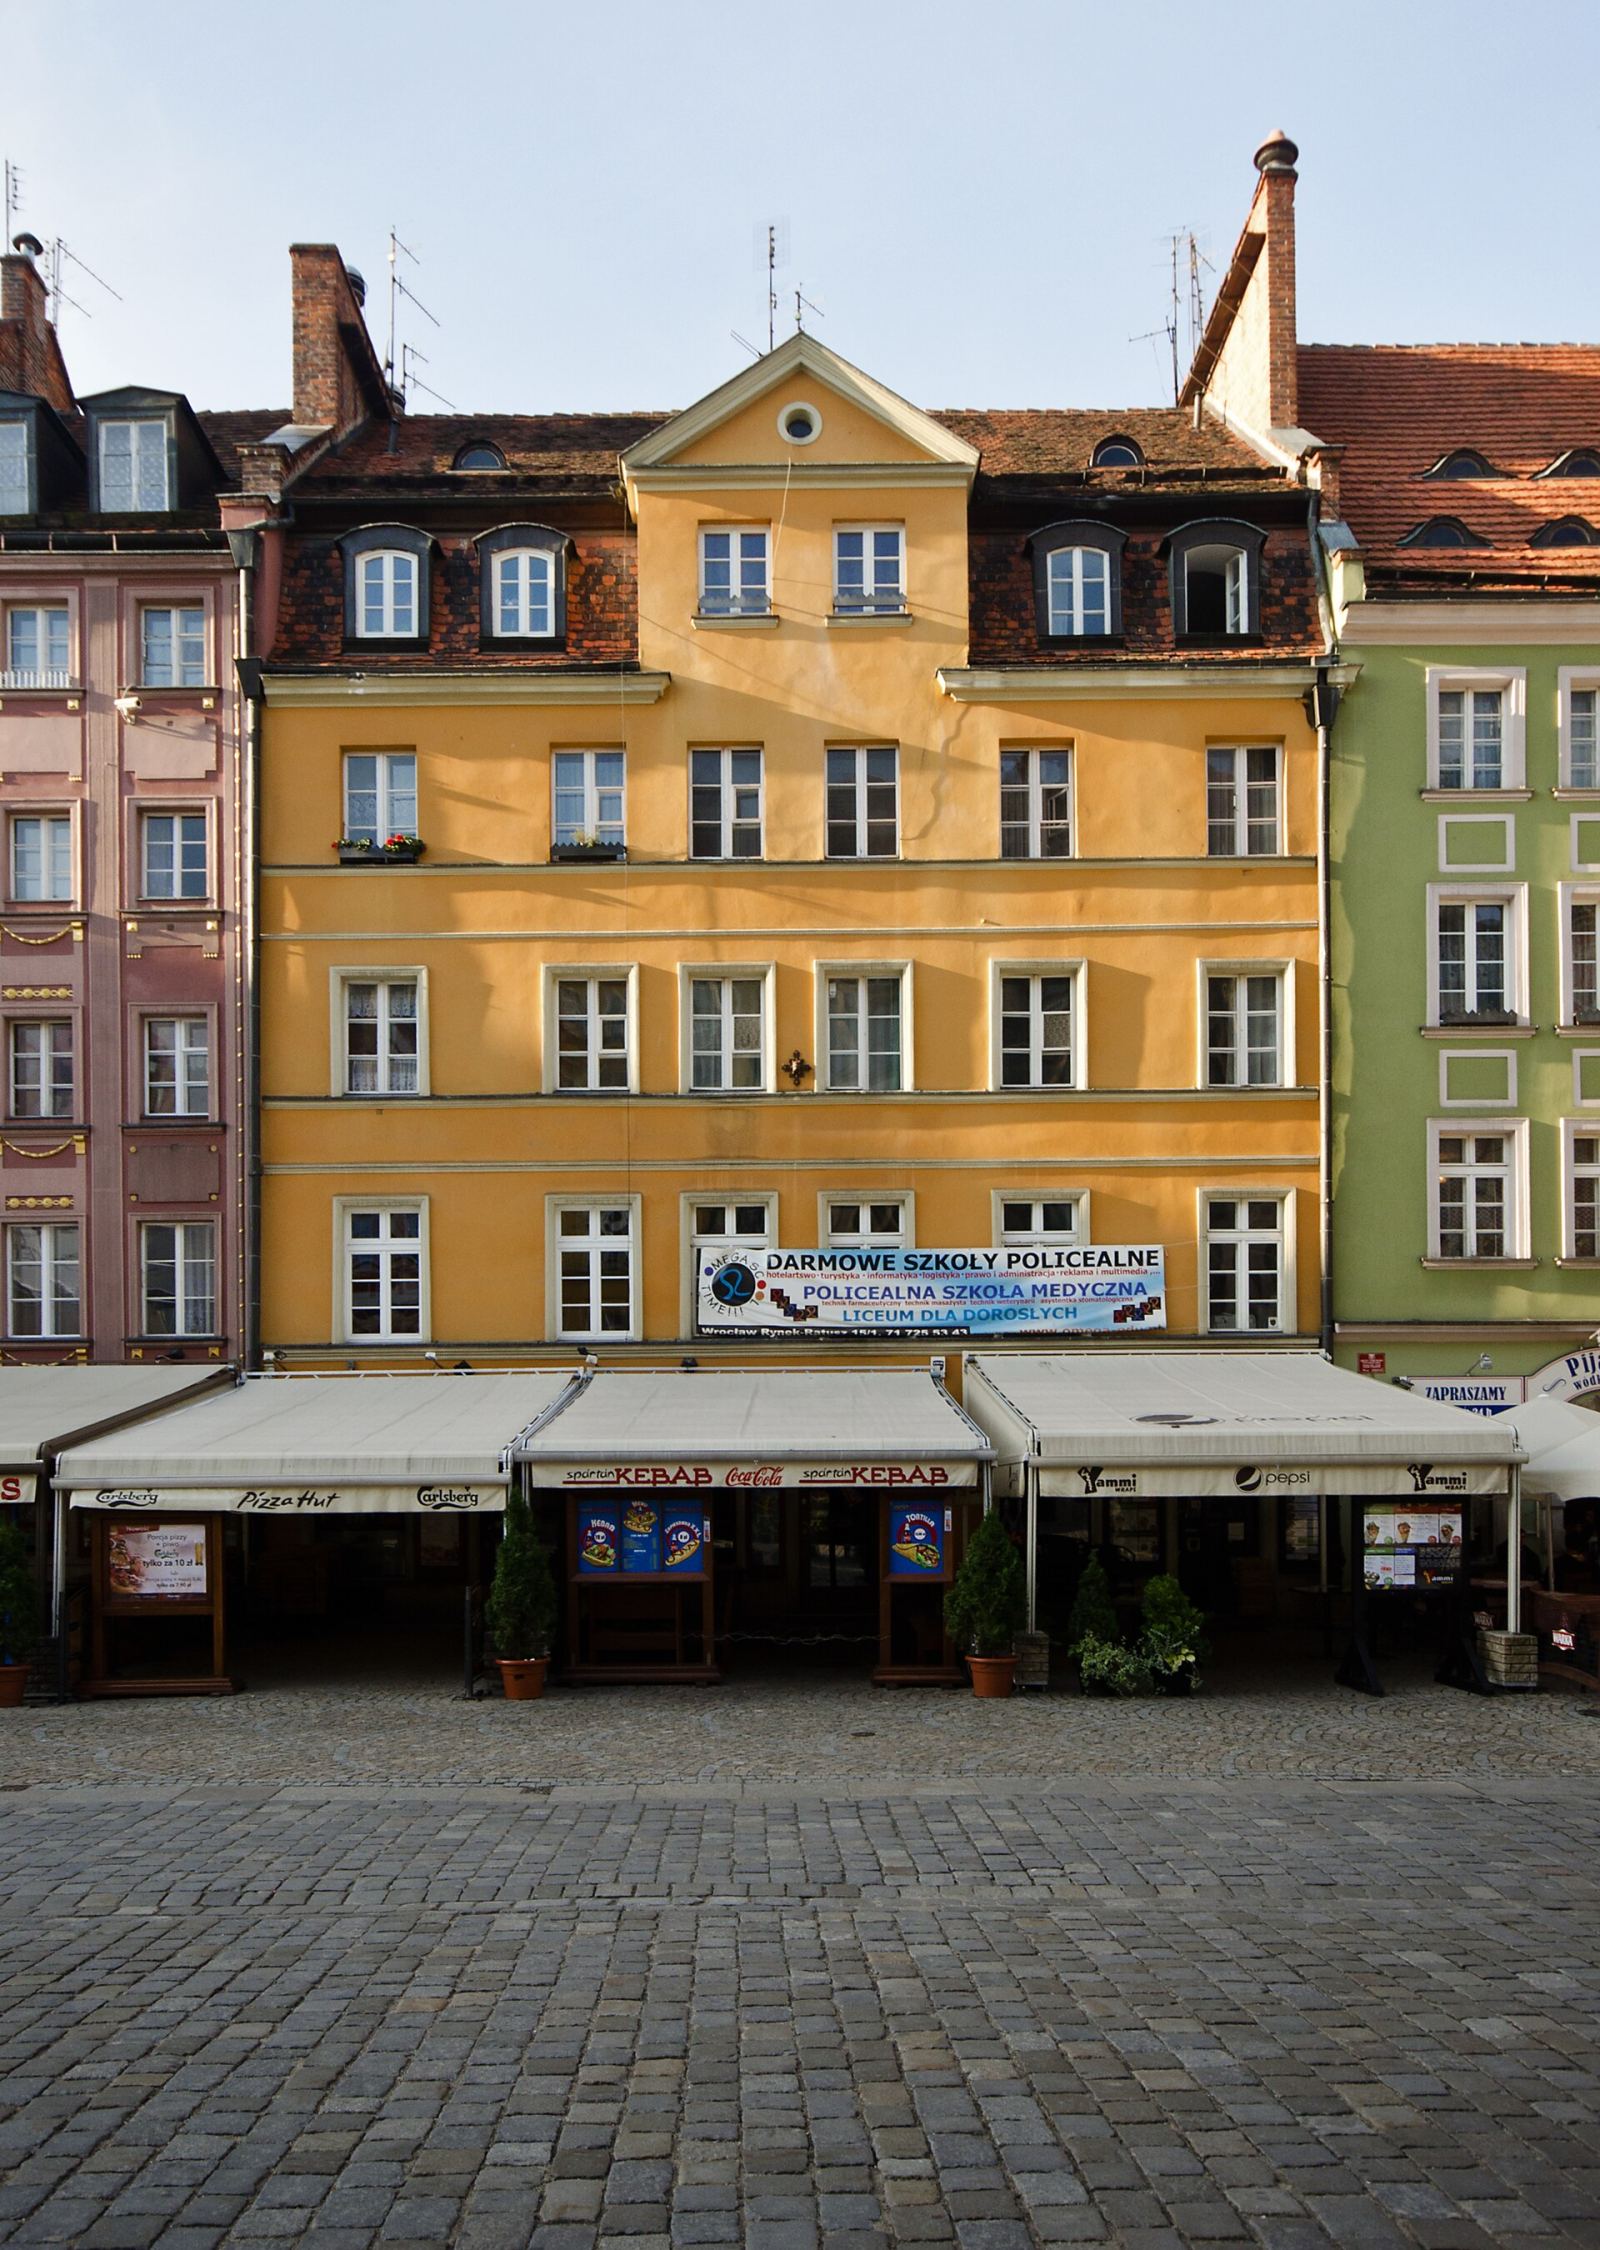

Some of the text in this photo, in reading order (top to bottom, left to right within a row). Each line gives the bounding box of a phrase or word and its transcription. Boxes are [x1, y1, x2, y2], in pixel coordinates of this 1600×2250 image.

[766, 1249, 1160, 1271] DARMOWE SZKOŁY POLICEALNE
[820, 1272, 860, 1281] turystyka
[867, 1271, 918, 1280] informatyka
[922, 1271, 960, 1280] logistyka
[965, 1272, 992, 1280] prawo
[998, 1269, 1055, 1279] administracja
[1060, 1268, 1094, 1276] reklama
[1101, 1267, 1148, 1276] multimedia
[803, 1282, 1148, 1301] POLICEALNA SZKOŁA MEDYCZNA
[842, 1306, 1078, 1322] LICEUM DLA DOROSŁYCH
[1565, 1352, 1600, 1378] Pij
[1425, 1386, 1507, 1401] ZAPRASZAMY
[614, 1465, 713, 1487] KEBAB
[851, 1465, 949, 1487] KEBAB
[1077, 1465, 1137, 1494] Yammi
[1265, 1471, 1311, 1486] pepsi
[1407, 1464, 1467, 1492] Yammi
[96, 1488, 158, 1508] Carlsberg
[237, 1490, 341, 1510] Pizza Hut
[416, 1485, 479, 1509] Carlsberg
[143, 1559, 163, 1568] tylko
[175, 1559, 185, 1567] 10
[186, 1559, 193, 1567] zł
